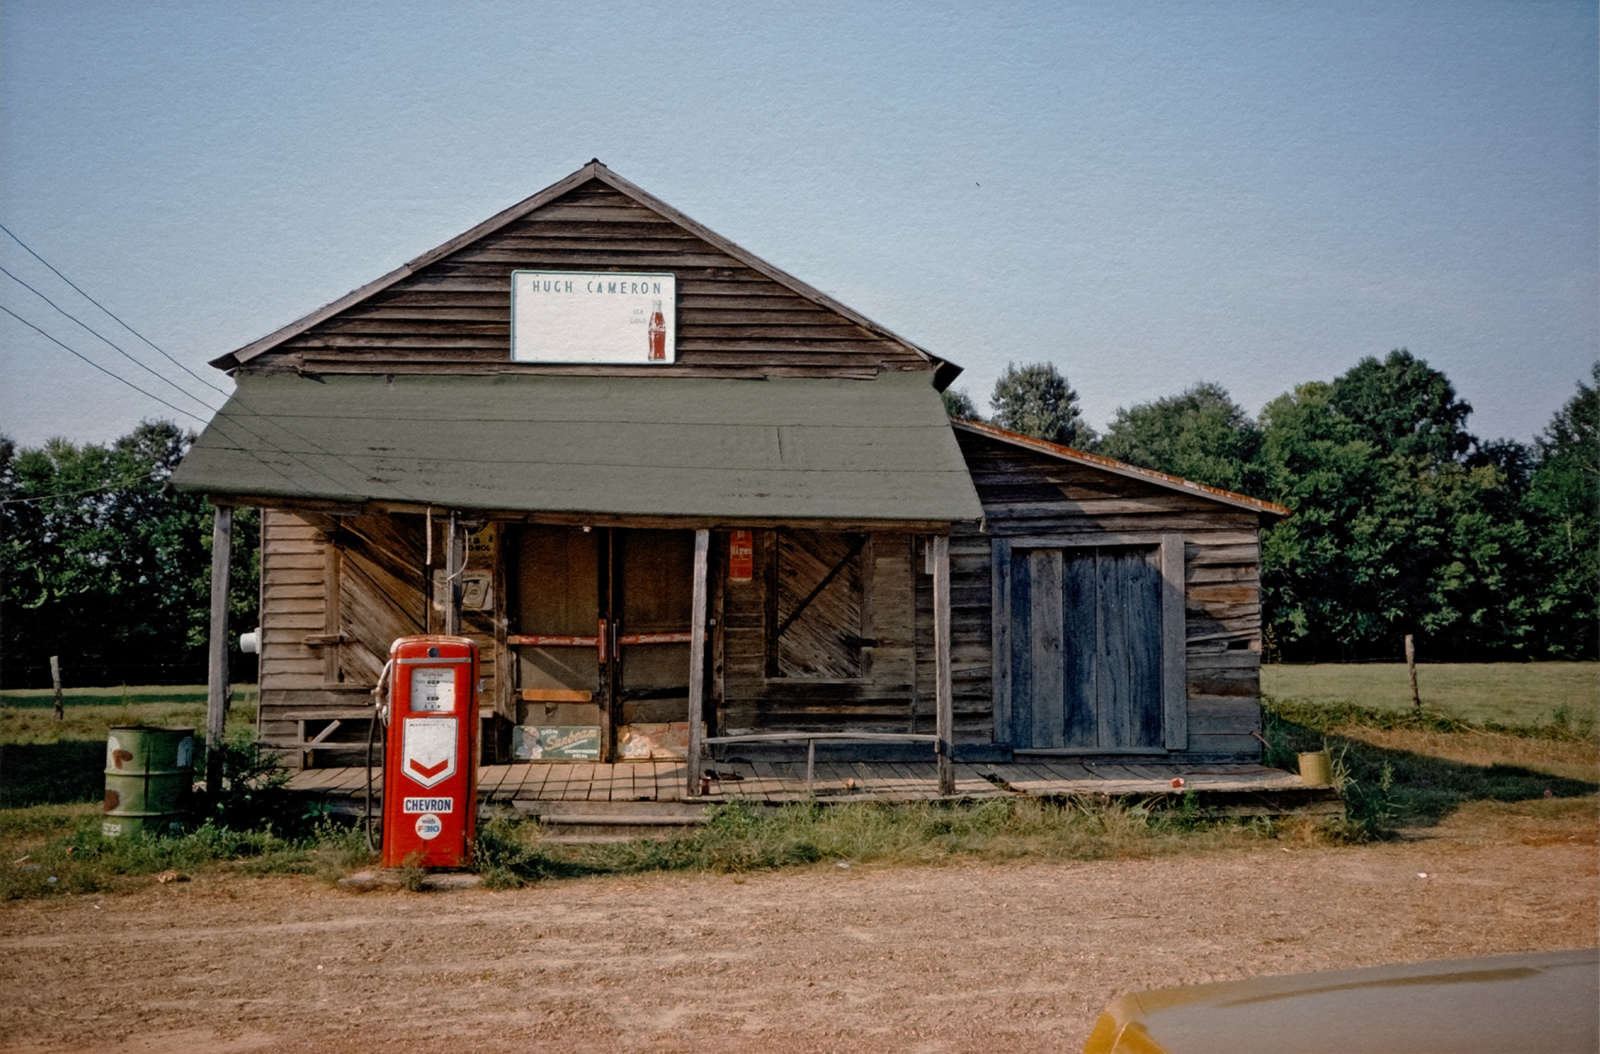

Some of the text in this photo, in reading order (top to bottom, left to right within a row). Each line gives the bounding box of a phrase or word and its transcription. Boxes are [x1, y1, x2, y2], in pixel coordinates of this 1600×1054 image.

[532, 280, 661, 294] HUGH CAMERON
[405, 799, 452, 811] CHEVRON
